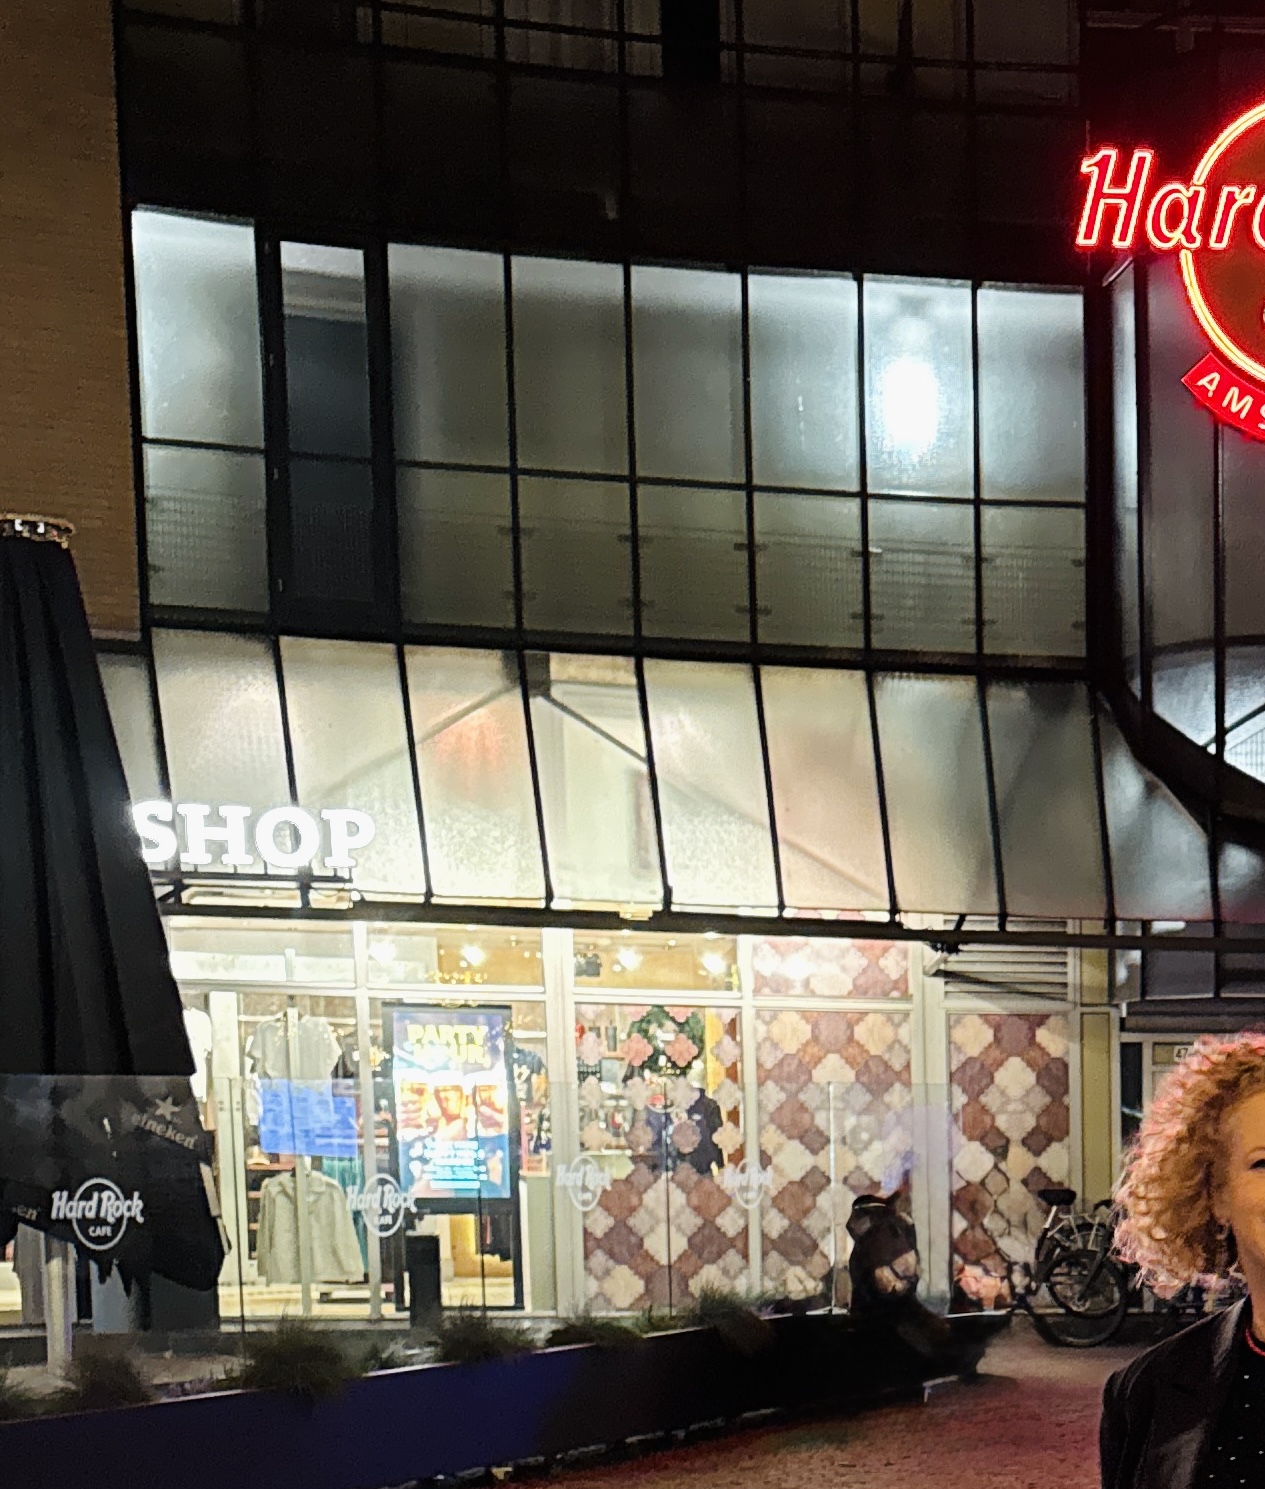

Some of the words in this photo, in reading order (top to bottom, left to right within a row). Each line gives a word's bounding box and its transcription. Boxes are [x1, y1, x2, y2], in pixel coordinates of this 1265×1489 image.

[132, 801, 376, 868] SHOP
[407, 1024, 489, 1046] PARTY
[51, 1190, 99, 1220] Hard
[99, 1190, 144, 1224] Rock
[88, 1226, 112, 1237] CAFE
